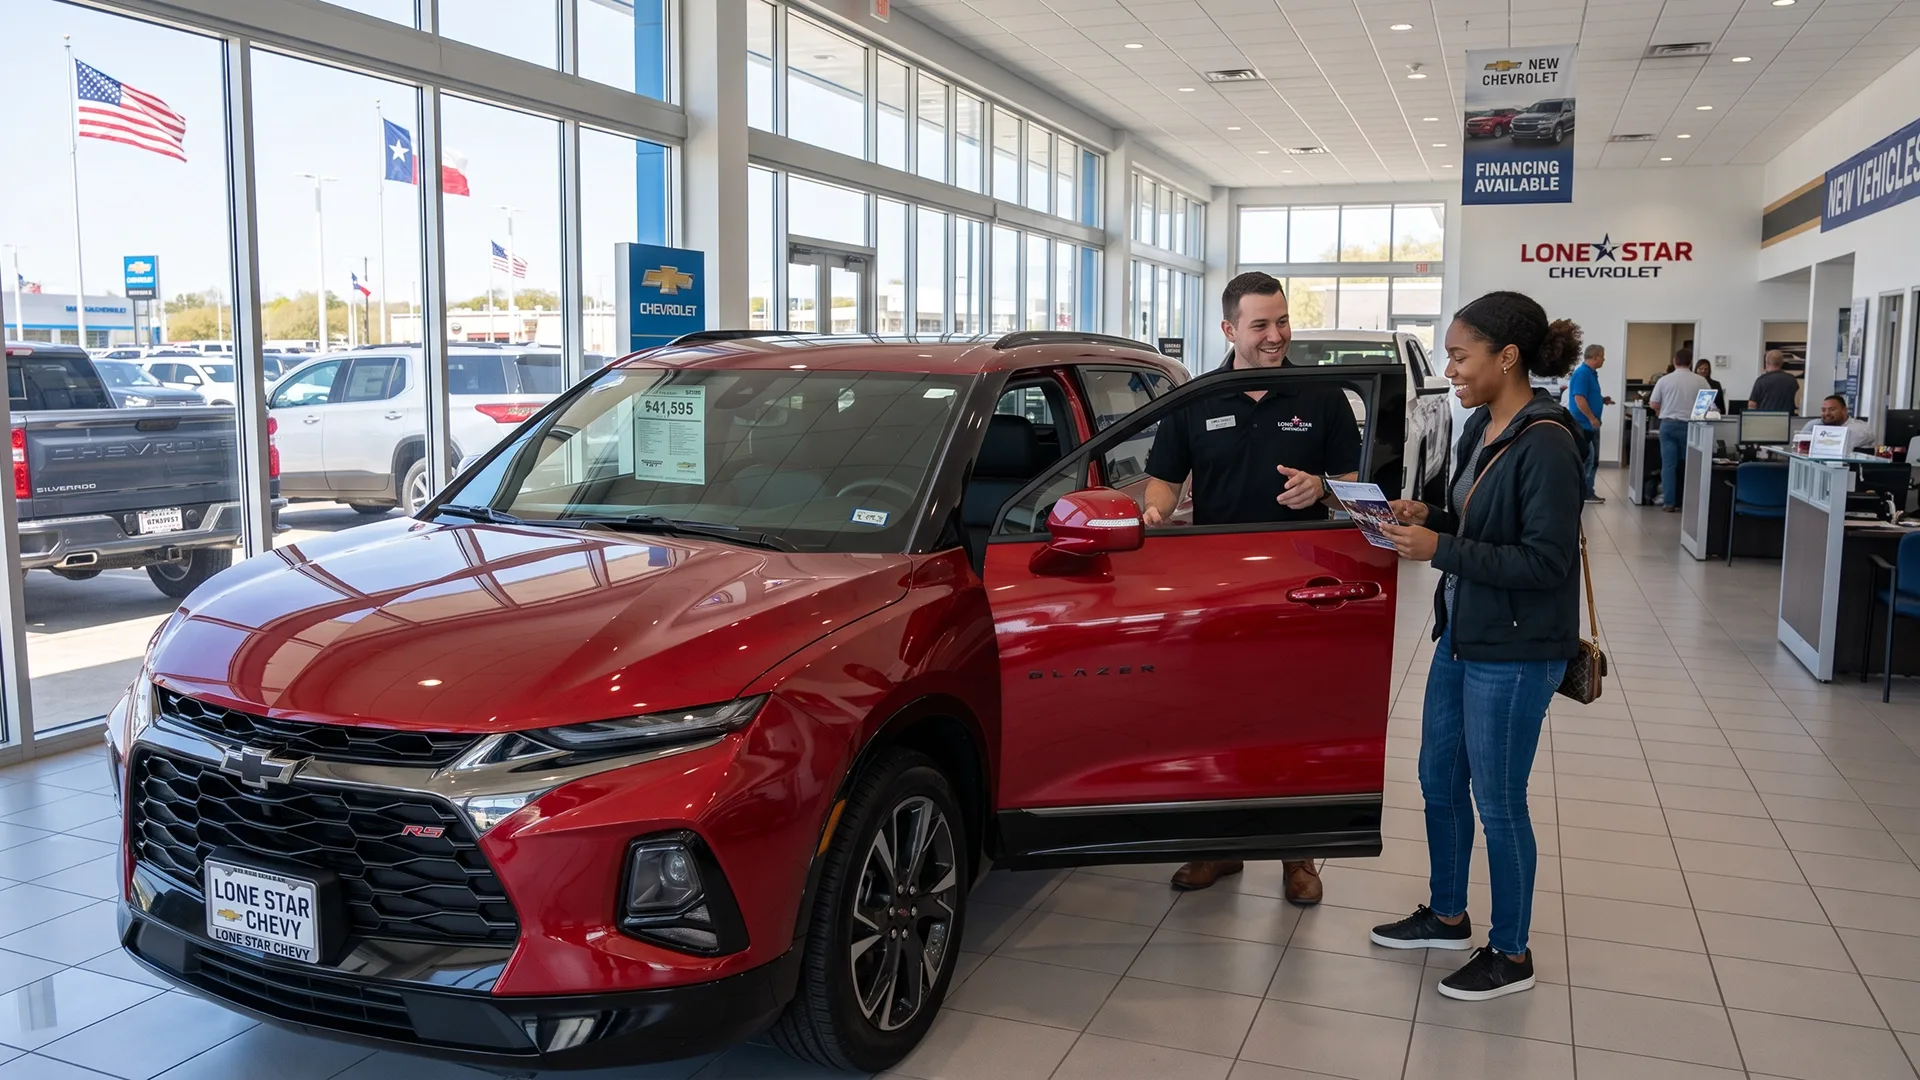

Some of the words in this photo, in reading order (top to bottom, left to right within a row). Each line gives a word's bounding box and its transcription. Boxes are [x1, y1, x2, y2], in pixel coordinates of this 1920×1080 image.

[1529, 58, 1559, 70] NEW
[1482, 72, 1558, 86] CHEVROLET
[1476, 160, 1559, 176] FINANCING
[1827, 168, 1855, 219] NEW
[1857, 132, 1920, 207] VEHICLES
[1475, 177, 1559, 192] AVAILABLE
[1521, 243, 1591, 262] LONE
[1621, 242, 1692, 262] STAR
[1549, 266, 1662, 278] CHEVROLET
[640, 302, 697, 317] CHEVROLET
[645, 400, 694, 417] $41,595
[52, 439, 236, 460] CHEVROLE
[37, 483, 96, 493] SILVERADO
[1028, 663, 1156, 680] BLAZER
[401, 825, 445, 838] RS
[214, 878, 260, 907] LONE
[264, 889, 310, 919] STAR
[246, 909, 301, 940] CHEVY
[215, 928, 243, 945] LONE
[245, 935, 271, 952] STAR
[273, 942, 310, 960] CHEVY
